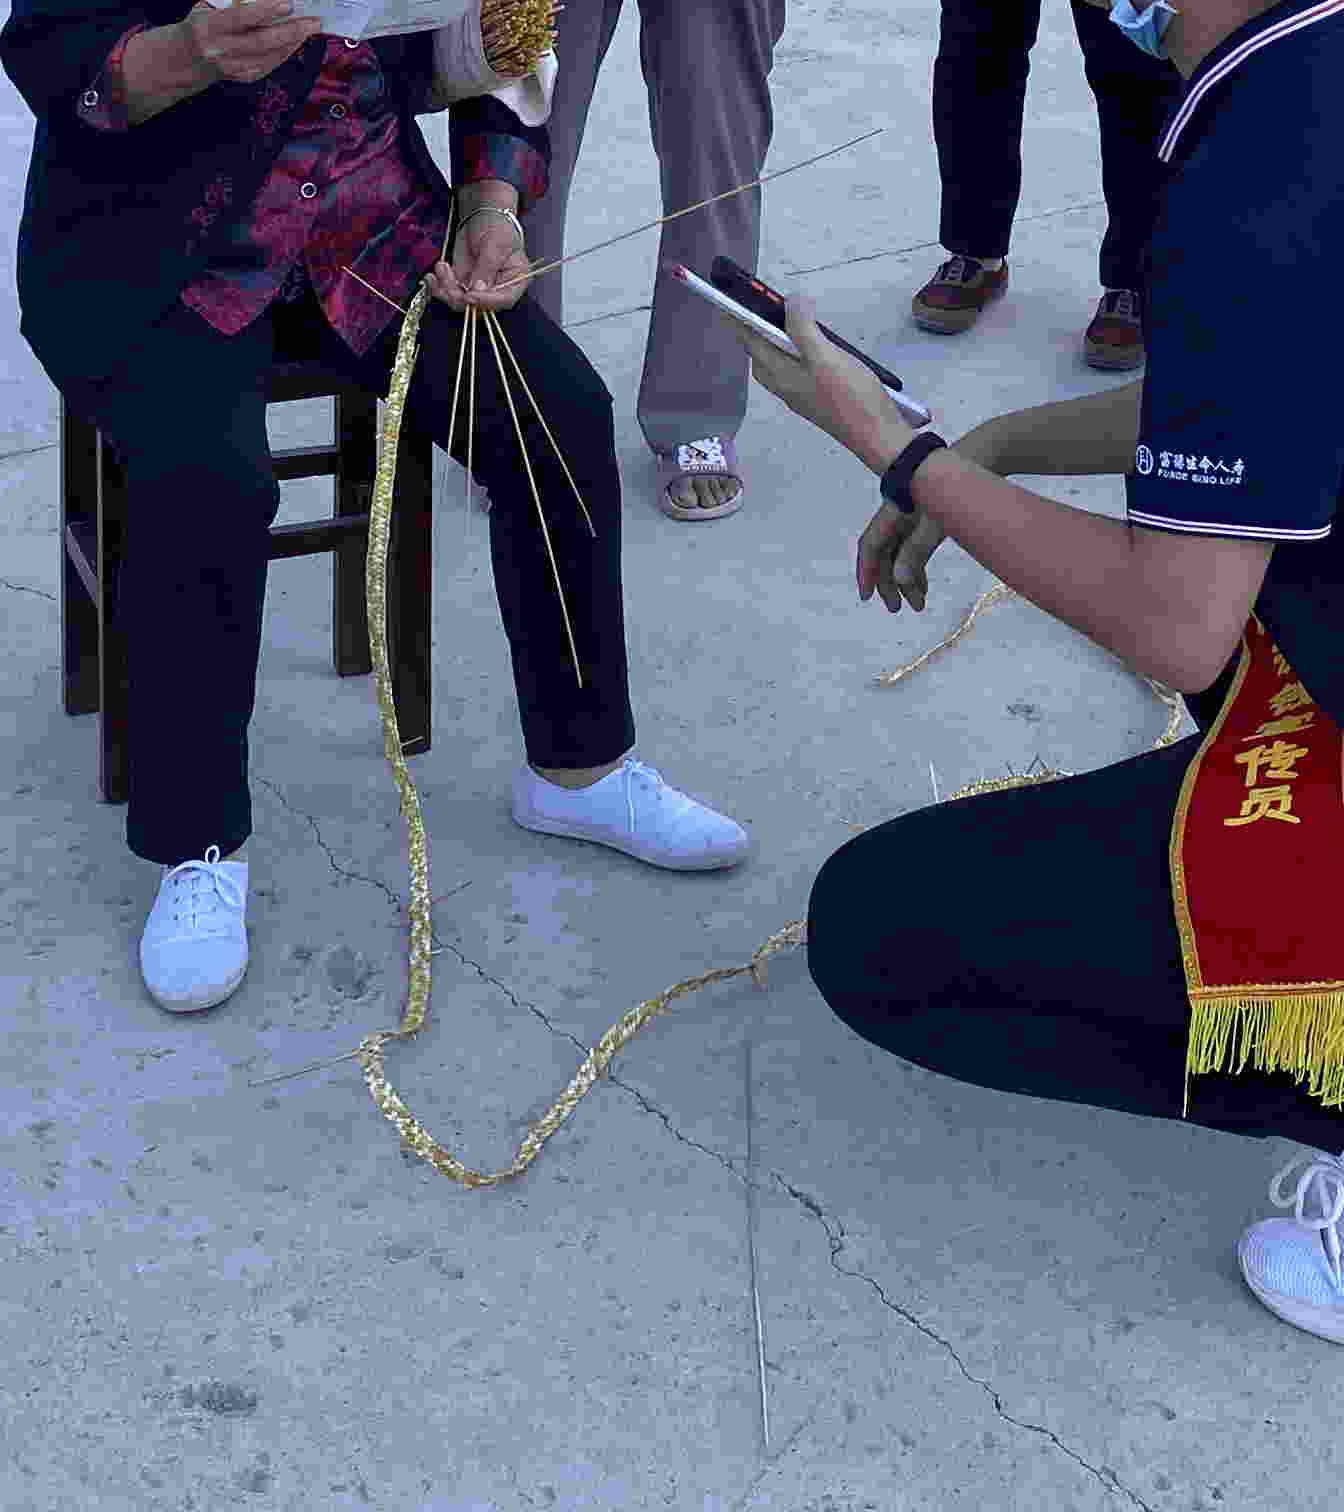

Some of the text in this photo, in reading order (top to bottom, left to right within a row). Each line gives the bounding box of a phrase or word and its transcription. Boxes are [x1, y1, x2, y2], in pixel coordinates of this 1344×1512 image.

[1158, 449, 1246, 477] 富德生命人寿
